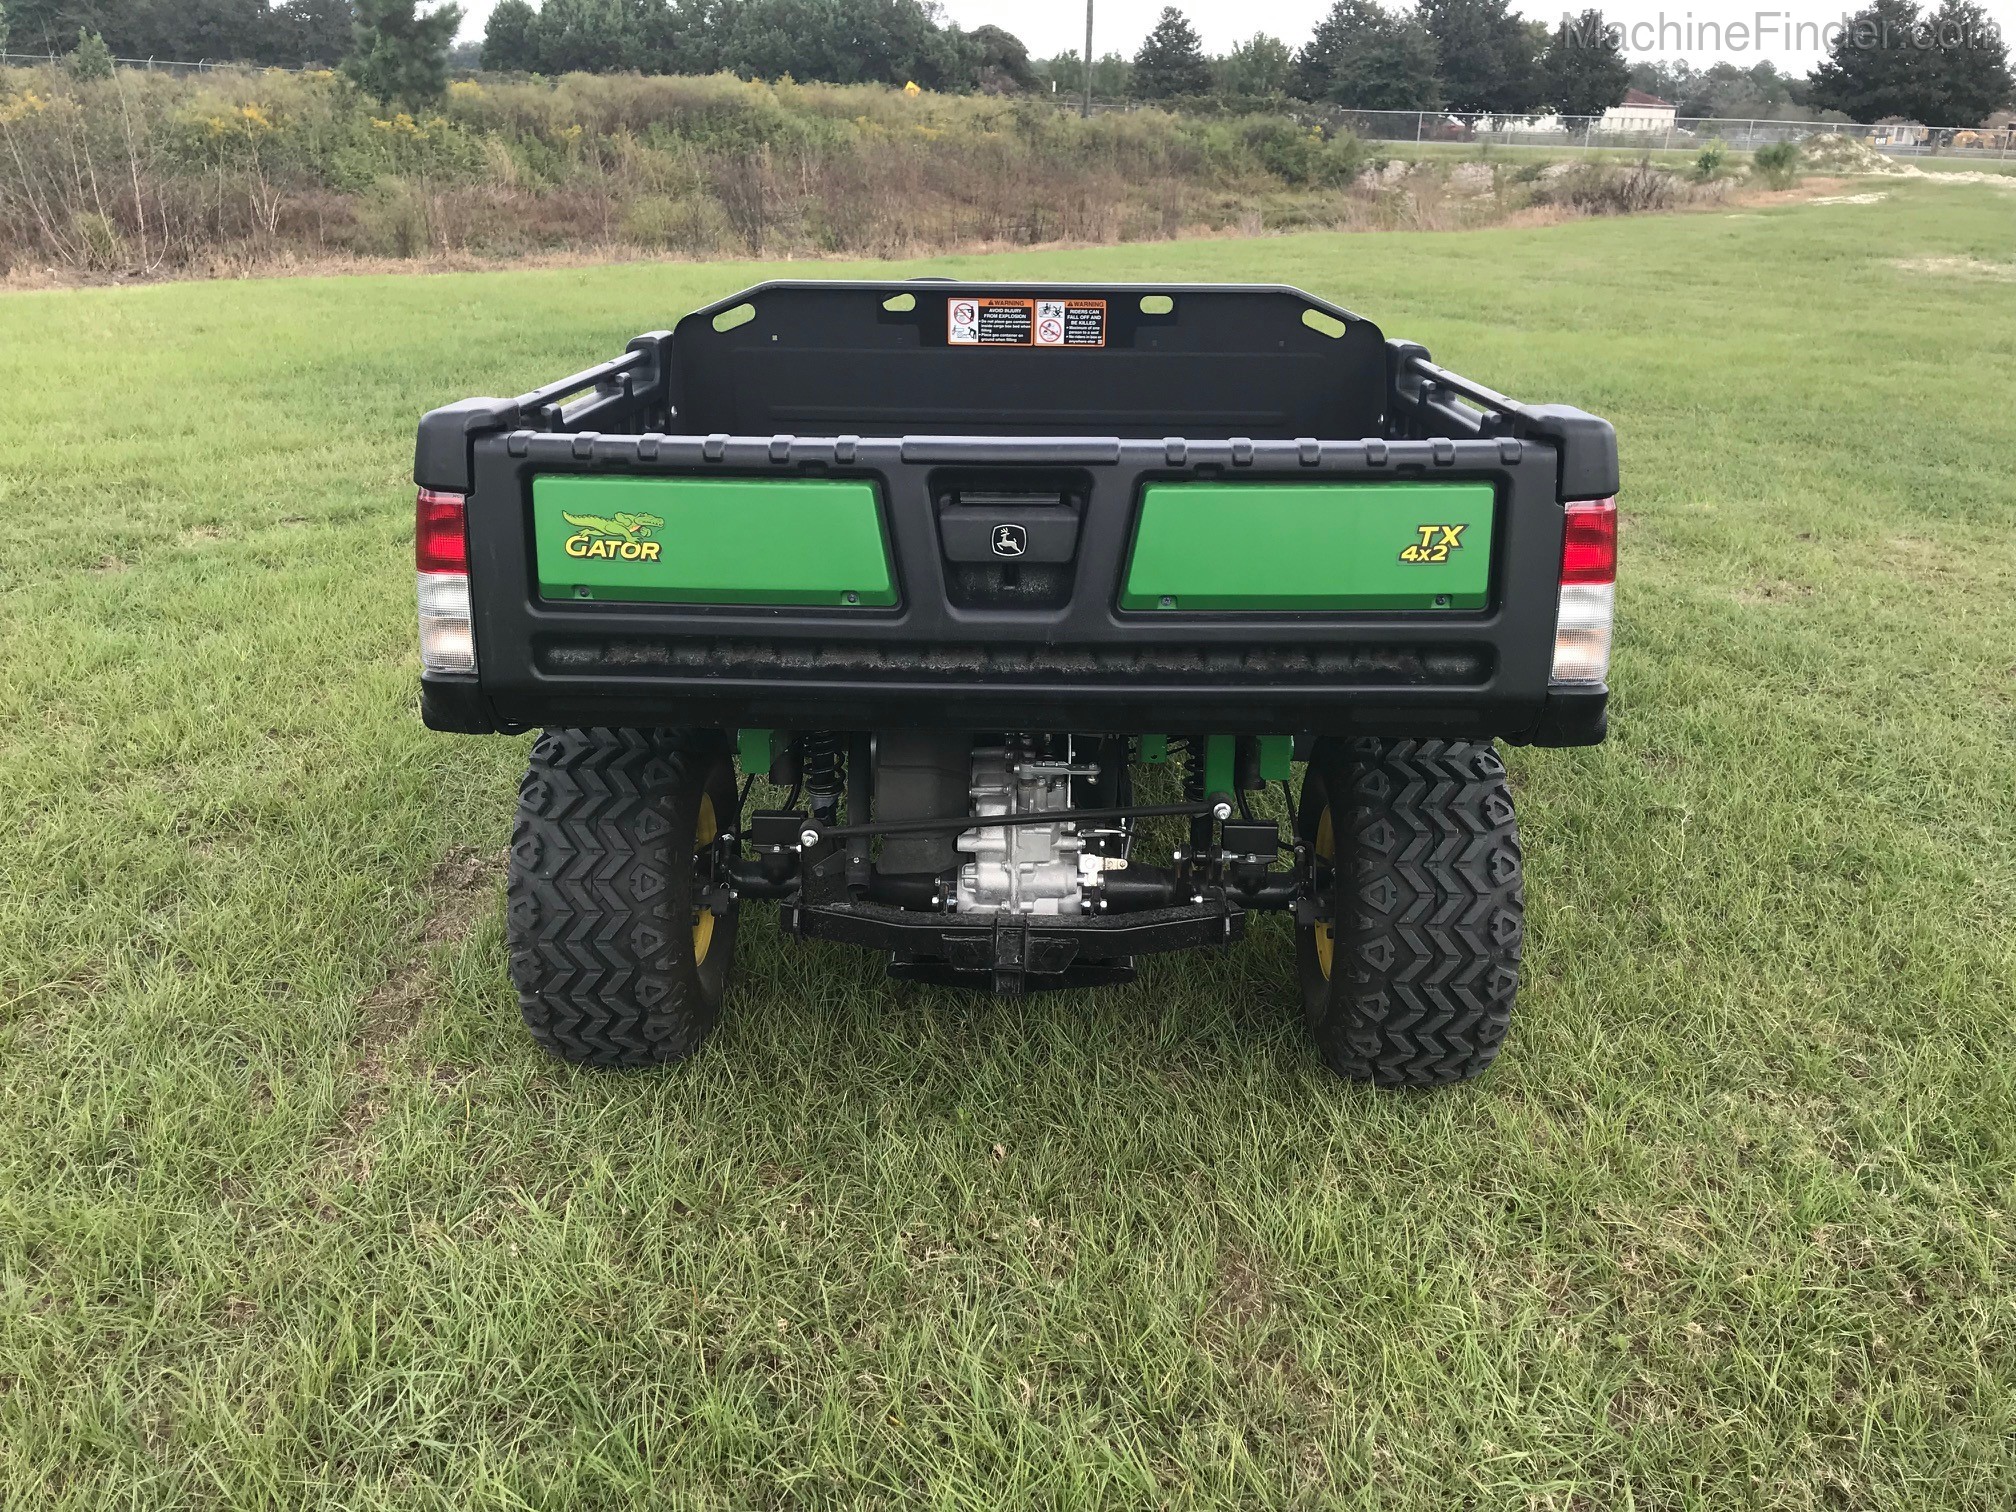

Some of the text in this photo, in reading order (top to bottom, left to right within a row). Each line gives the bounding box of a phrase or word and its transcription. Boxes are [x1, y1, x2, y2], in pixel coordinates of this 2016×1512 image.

[1417, 524, 1467, 548] TX
[565, 535, 662, 562] GATOR
[1399, 545, 1448, 563] 4x2
